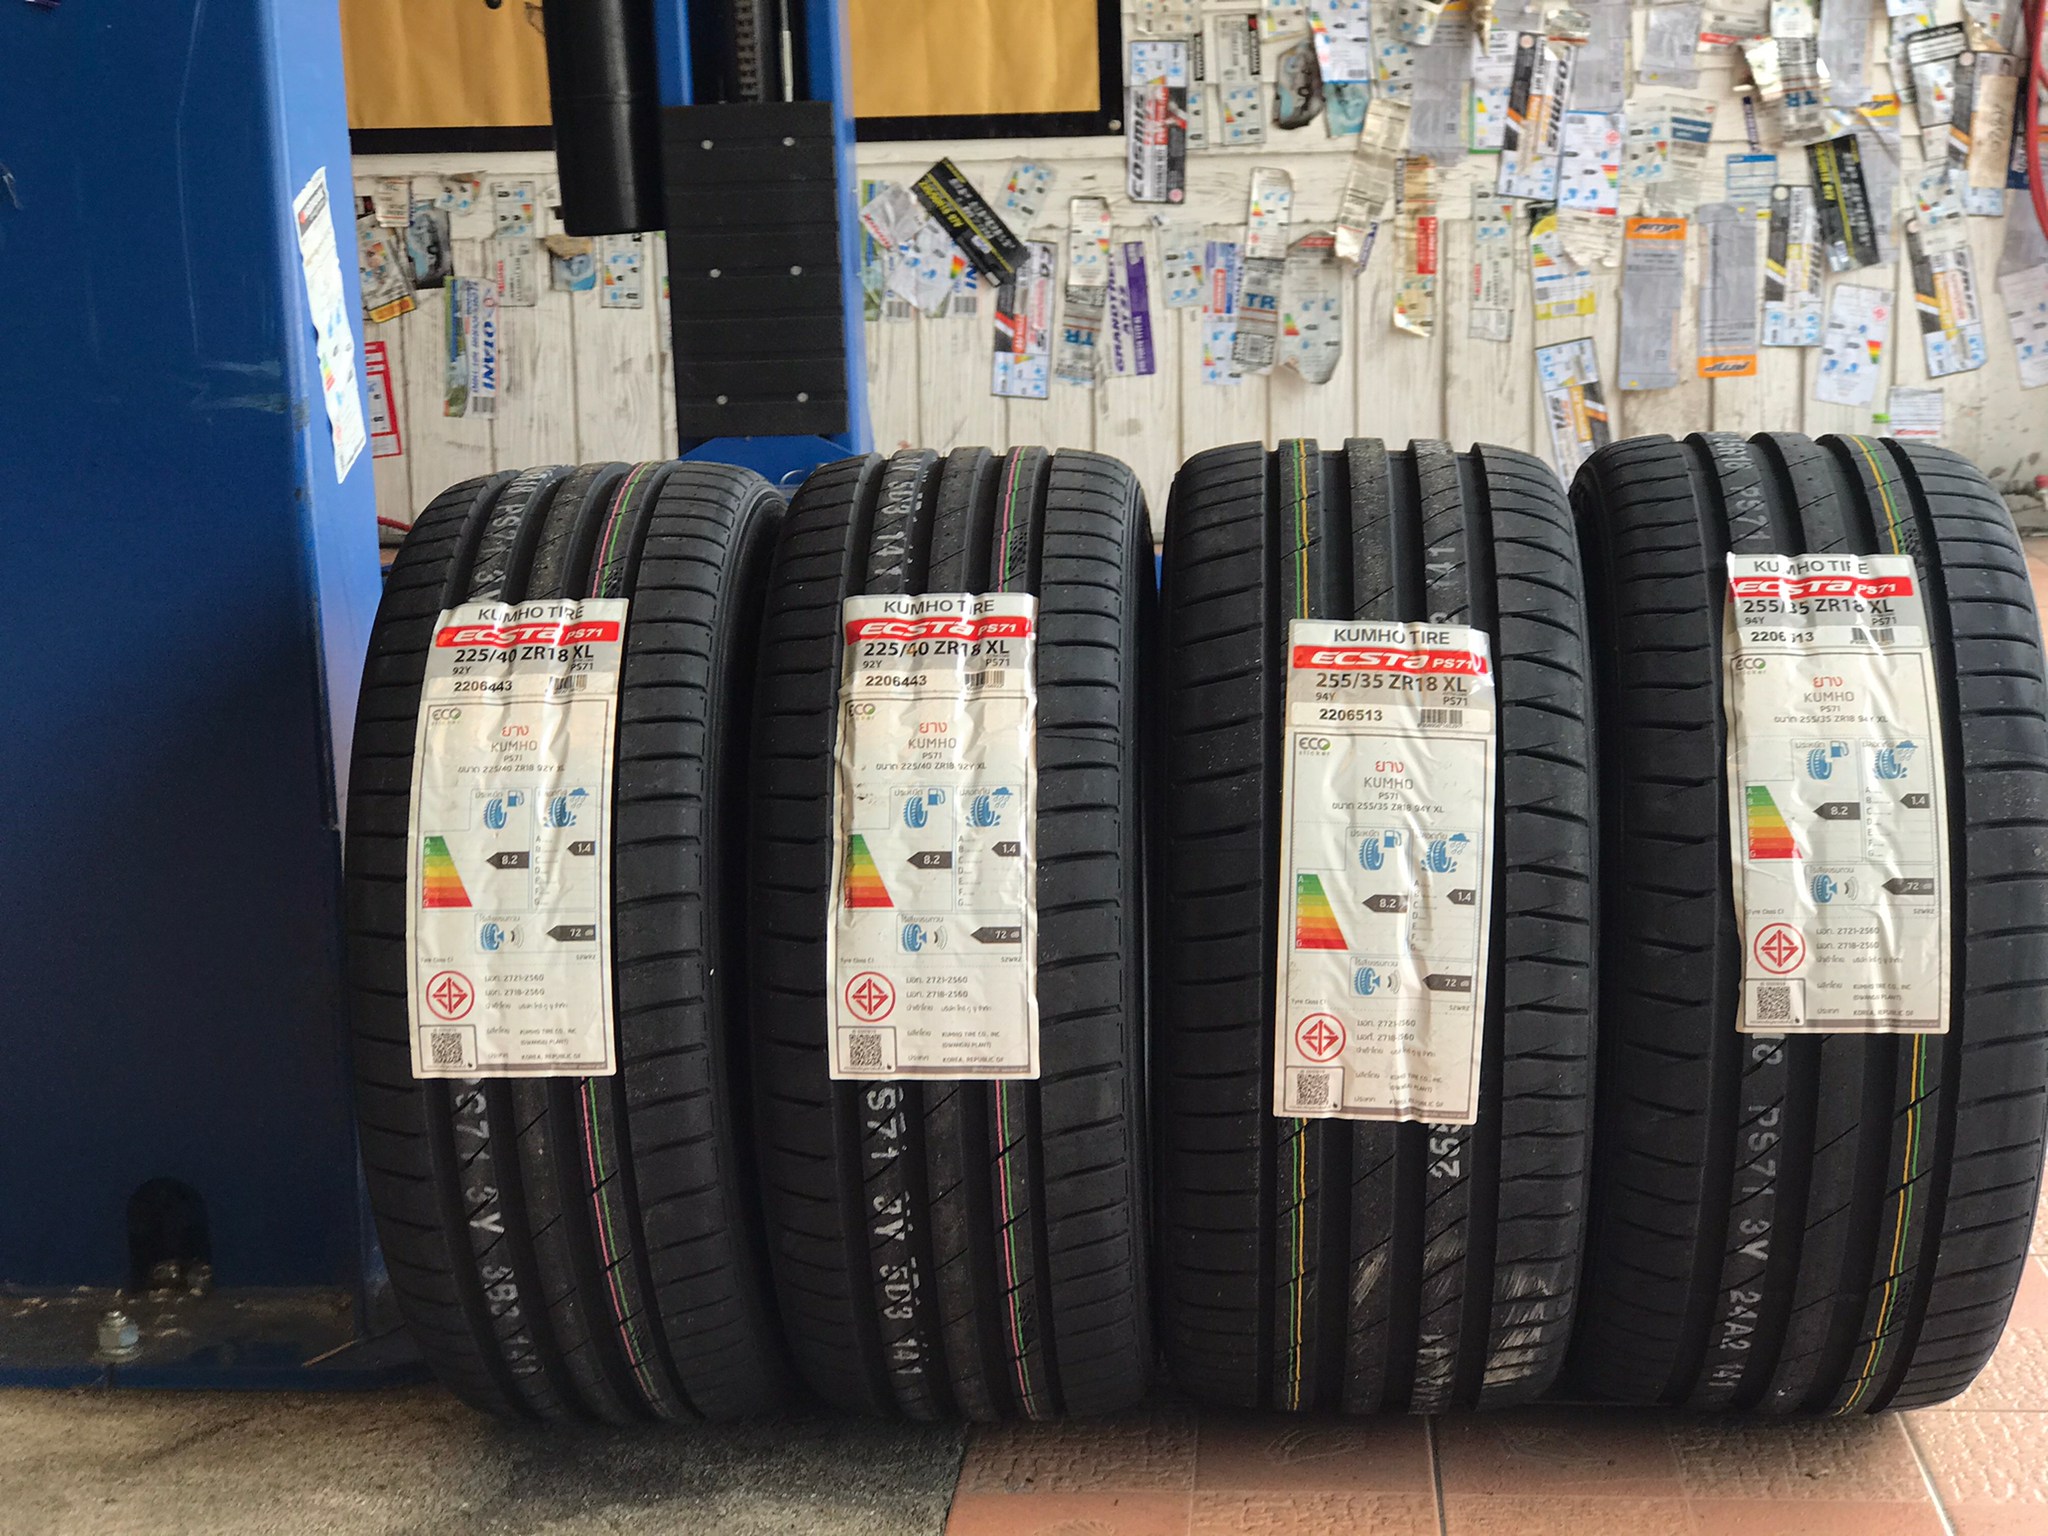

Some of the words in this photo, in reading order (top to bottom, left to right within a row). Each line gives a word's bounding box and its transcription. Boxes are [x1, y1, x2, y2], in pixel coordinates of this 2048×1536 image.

[1247, 292, 1276, 309] TR
[1065, 329, 1094, 346] TR
[482, 321, 497, 390] OTANI
[1730, 486, 1772, 540] PS71
[1857, 584, 1897, 594] PS71
[884, 600, 953, 615] KUMHO
[1870, 599, 1894, 613] XL
[1872, 617, 1897, 625] PS71
[566, 628, 603, 640] PS71
[978, 624, 1017, 636] PS71
[1334, 629, 1405, 644] KUMHO
[1409, 631, 1450, 645] TIRE
[454, 648, 517, 663] 225/40
[521, 646, 569, 662] ZR18
[572, 644, 594, 659] XL
[863, 642, 929, 658] 225/40
[934, 641, 981, 657] ZR18
[986, 640, 1010, 654] XL
[452, 666, 471, 675] 92Y
[571, 662, 594, 672] PS71
[863, 660, 882, 669] 92Y
[986, 658, 1010, 667] PS71
[1431, 657, 1473, 669] PS71
[453, 680, 512, 692] 2206443
[865, 675, 927, 687] 2206443
[1315, 672, 1384, 689] 255/35
[1388, 673, 1438, 692] ZR18
[1443, 676, 1467, 693] XL
[1813, 676, 1843, 688] ยาง
[1315, 692, 1335, 701] 94Y
[1443, 697, 1468, 706] PS71
[1803, 691, 1855, 703] KUMHO
[1319, 708, 1383, 721] 2206513
[502, 725, 529, 737] ยาง
[919, 721, 947, 734] ยาง
[491, 740, 538, 752] KUMHO
[908, 738, 957, 749] KUMHO
[1299, 737, 1331, 751] ECO
[503, 754, 523, 762] PS71
[901, 762, 931, 770] 225/40
[1375, 760, 1404, 773] ยาง
[1363, 776, 1414, 790] KUMHO
[1378, 792, 1399, 800] PS71
[1910, 795, 1926, 805] 1.4
[1357, 802, 1388, 810] 255/35
[1830, 806, 1849, 816] 8.2
[577, 843, 592, 853] 1.4
[1002, 844, 1017, 853] 1.4
[501, 855, 518, 865] 8.2
[923, 855, 941, 865] 8.2
[1457, 892, 1472, 902] 1.4
[1379, 899, 1397, 908] 8.2
[1742, 1104, 1781, 1196] PS71
[1737, 1218, 1773, 1261] 3Y
